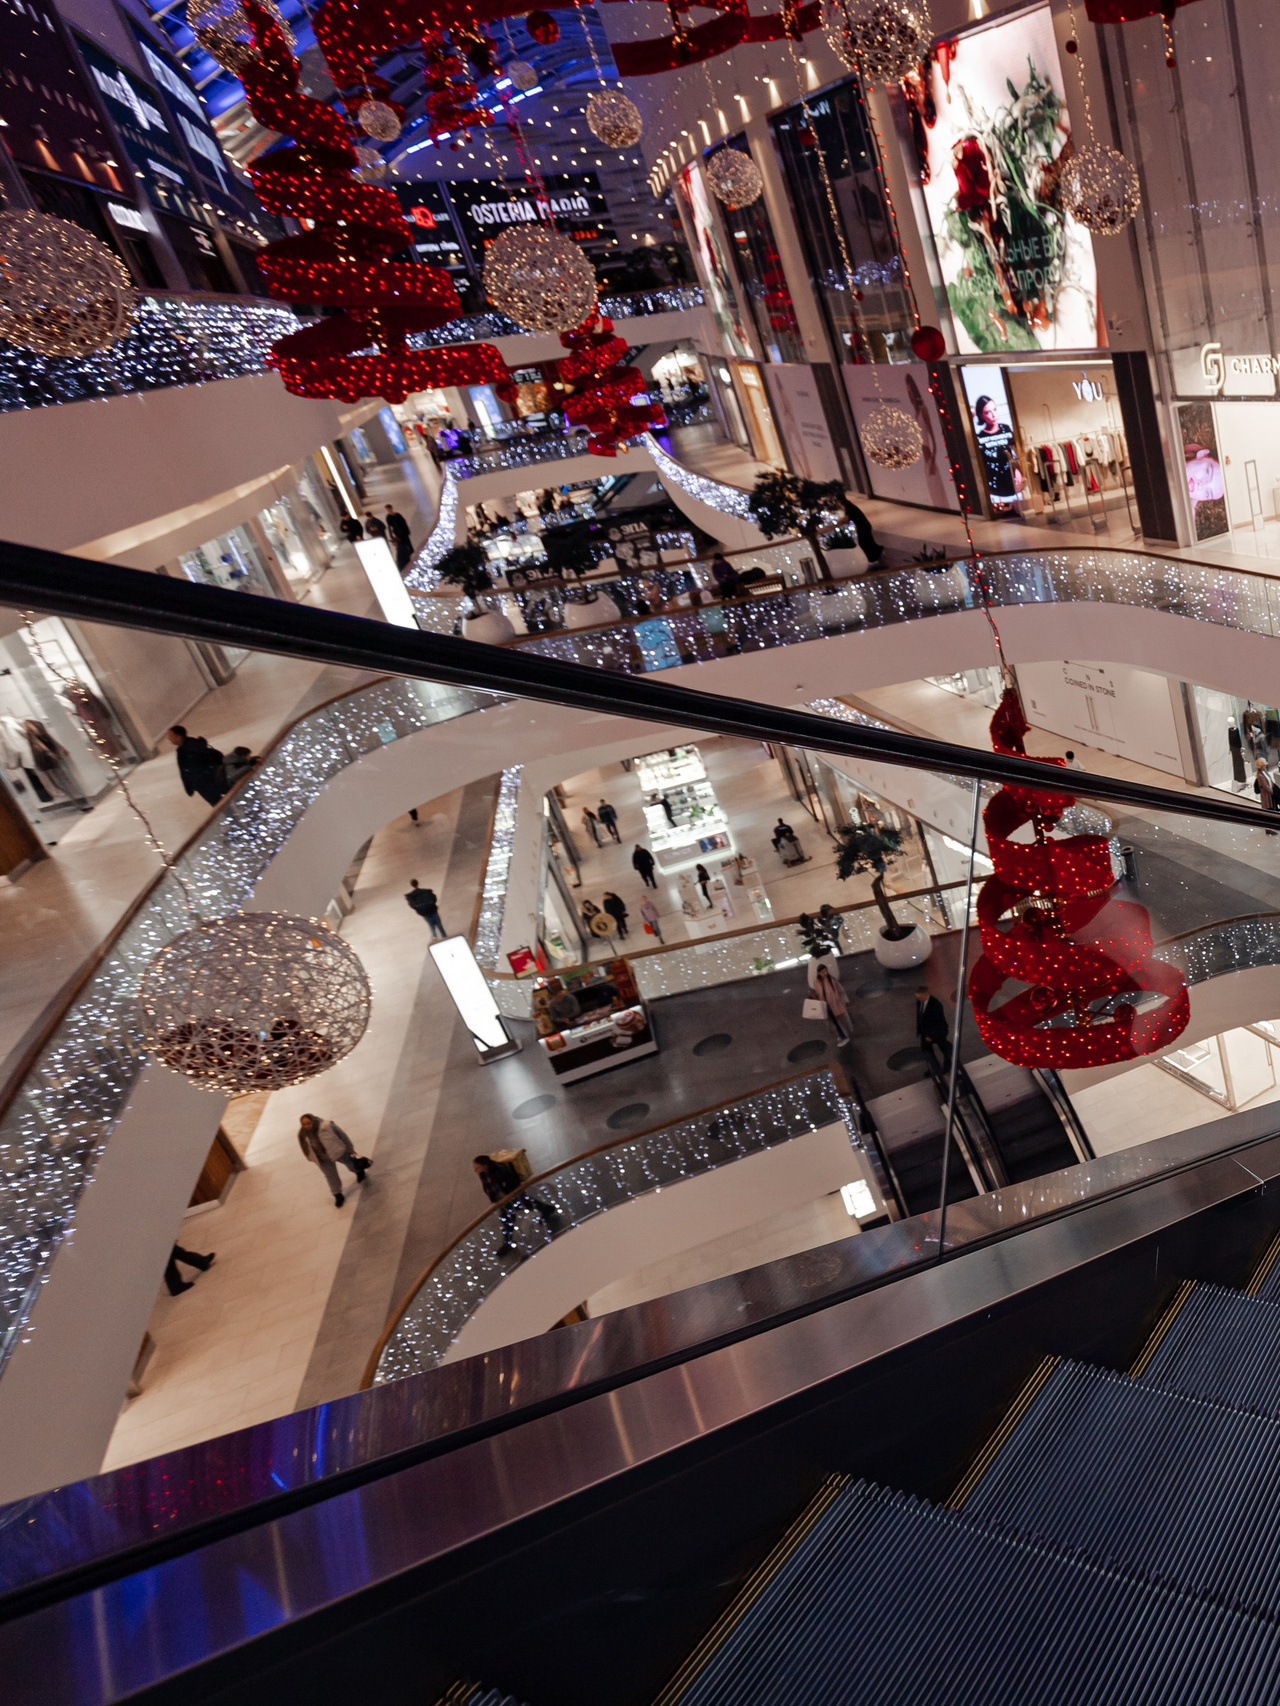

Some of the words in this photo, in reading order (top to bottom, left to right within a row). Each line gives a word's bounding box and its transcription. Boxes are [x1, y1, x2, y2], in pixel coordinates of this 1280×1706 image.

[470, 200, 538, 225] OSTERIA
[1072, 378, 1103, 403] YOU
[1064, 676, 1088, 691] COINED
[1088, 684, 1095, 692] IN
[1095, 685, 1117, 698] STONE
